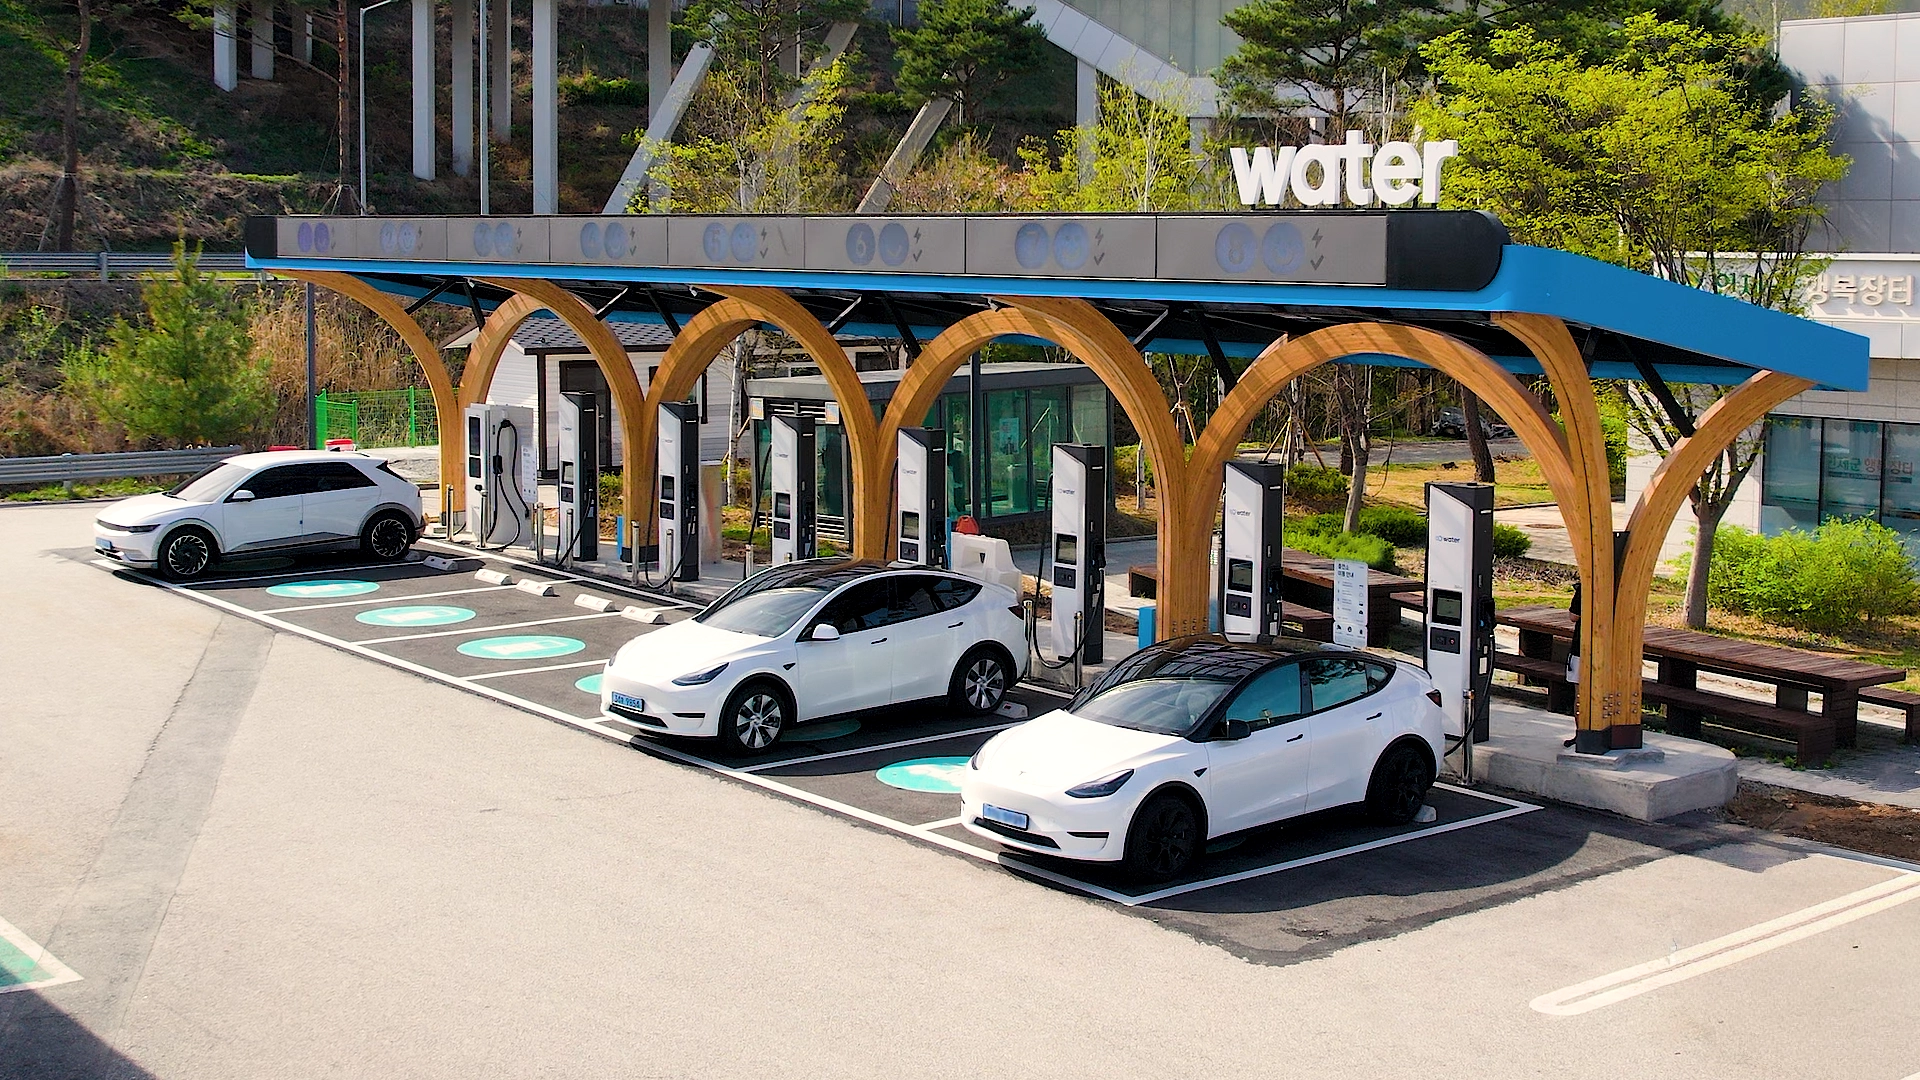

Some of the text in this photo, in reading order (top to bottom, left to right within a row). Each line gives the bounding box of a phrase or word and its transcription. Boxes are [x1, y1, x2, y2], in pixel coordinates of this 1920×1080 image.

[1230, 130, 1458, 206] water
[856, 229, 867, 259] 6
[1236, 509, 1251, 517] water
[1443, 536, 1461, 544] water
